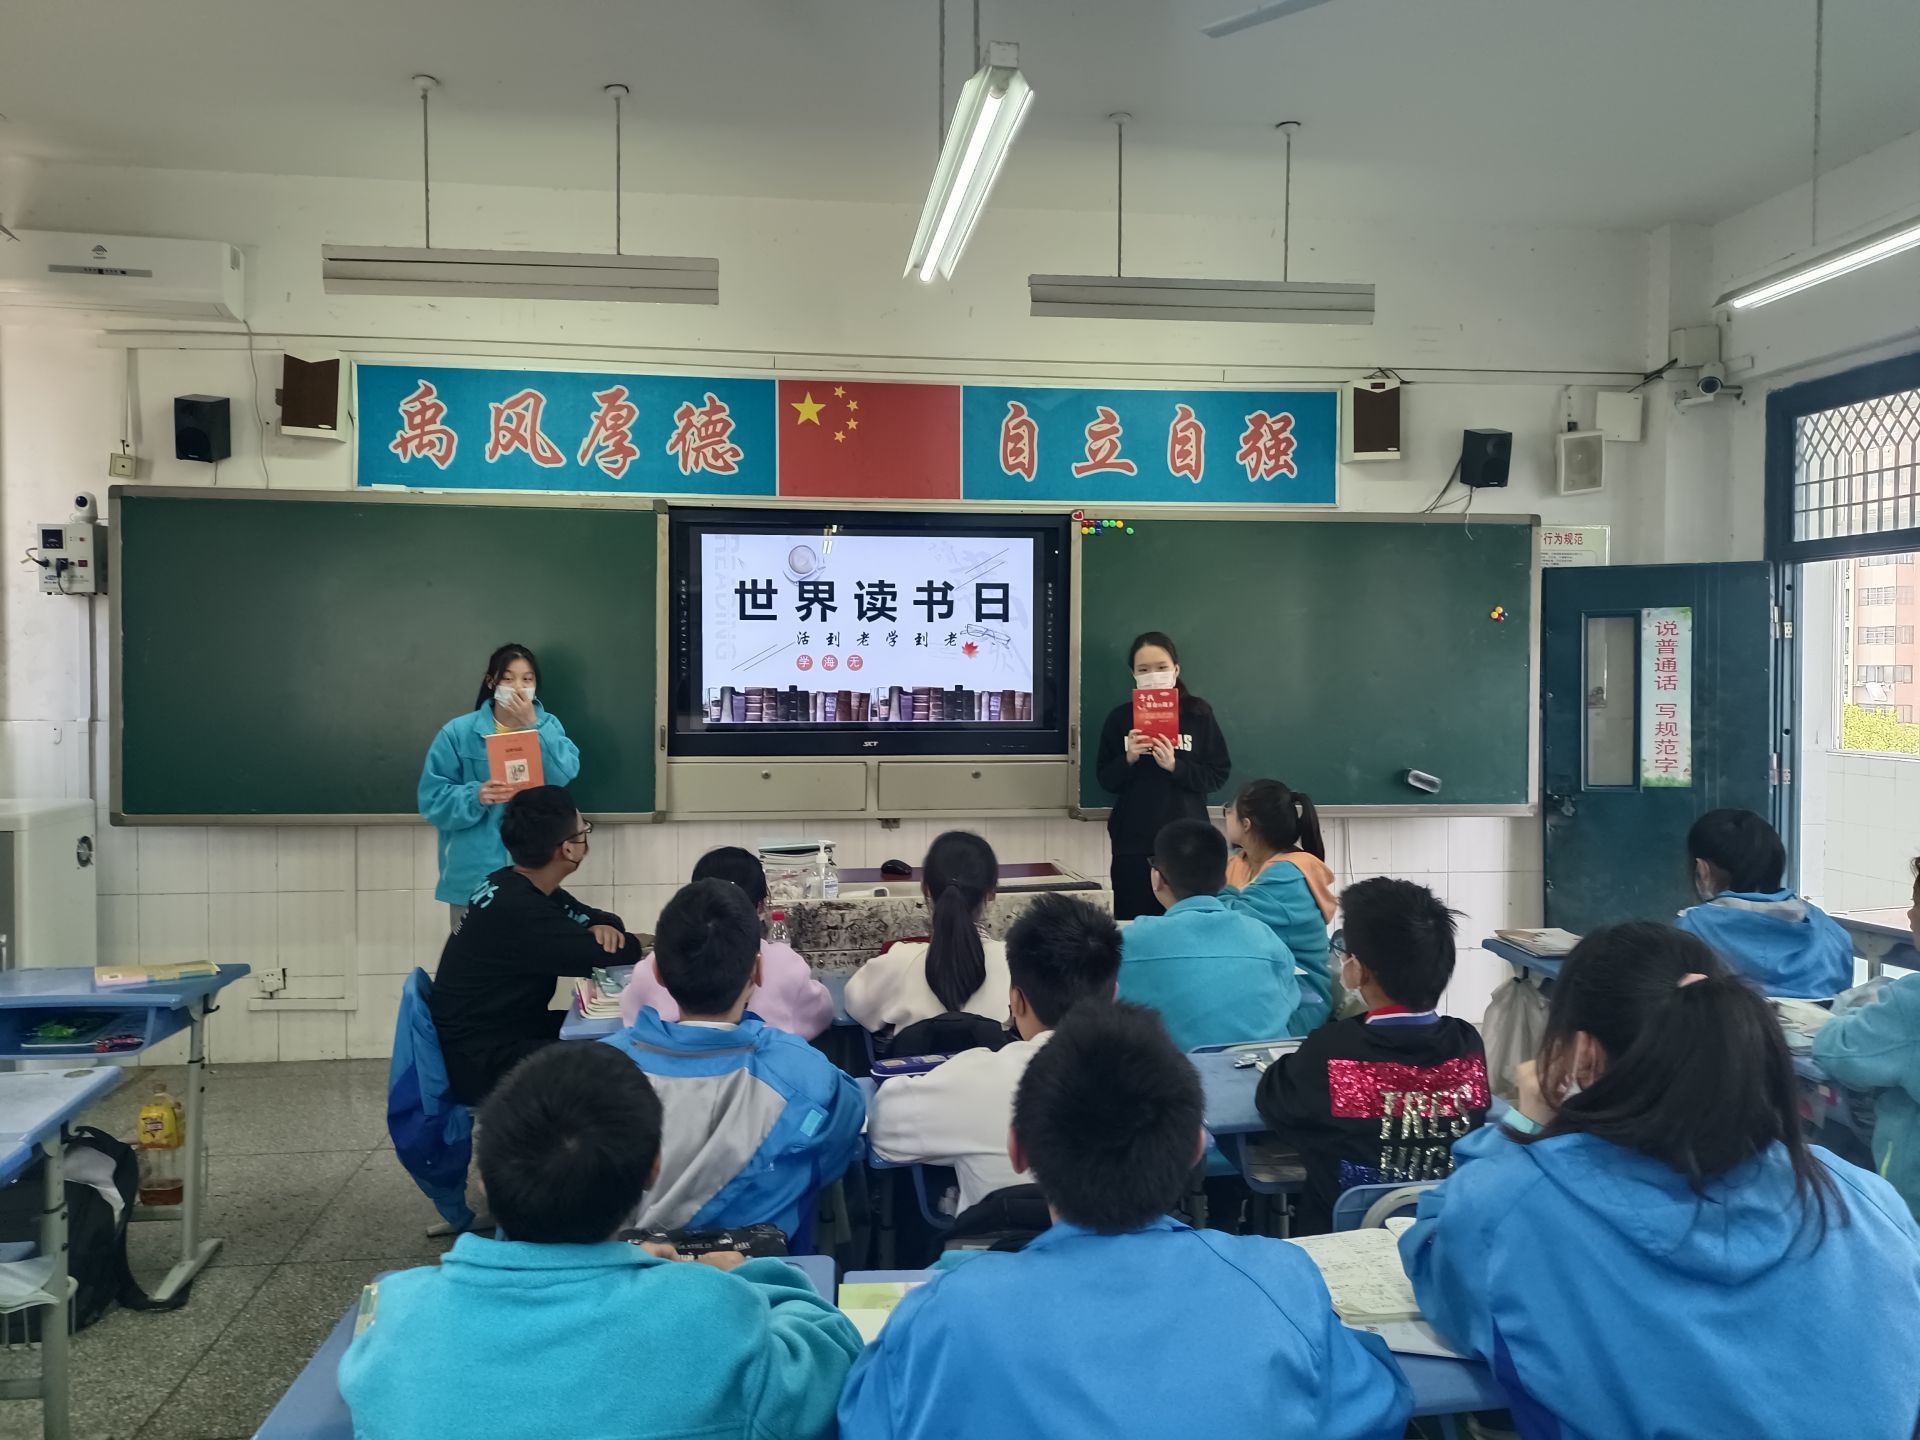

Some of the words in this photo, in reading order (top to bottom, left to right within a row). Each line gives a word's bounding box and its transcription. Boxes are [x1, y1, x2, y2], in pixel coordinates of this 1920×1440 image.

[389, 379, 744, 479] 禹风厚德
[1000, 401, 1298, 483] 自立自强
[1543, 532, 1584, 545] 行为规范
[734, 579, 1010, 623] 世界读书日
[796, 630, 958, 648] 活到老学到老
[798, 656, 861, 669] 学海无
[1654, 620, 1680, 692] 说普通话
[1654, 702, 1680, 774] 写规范字
